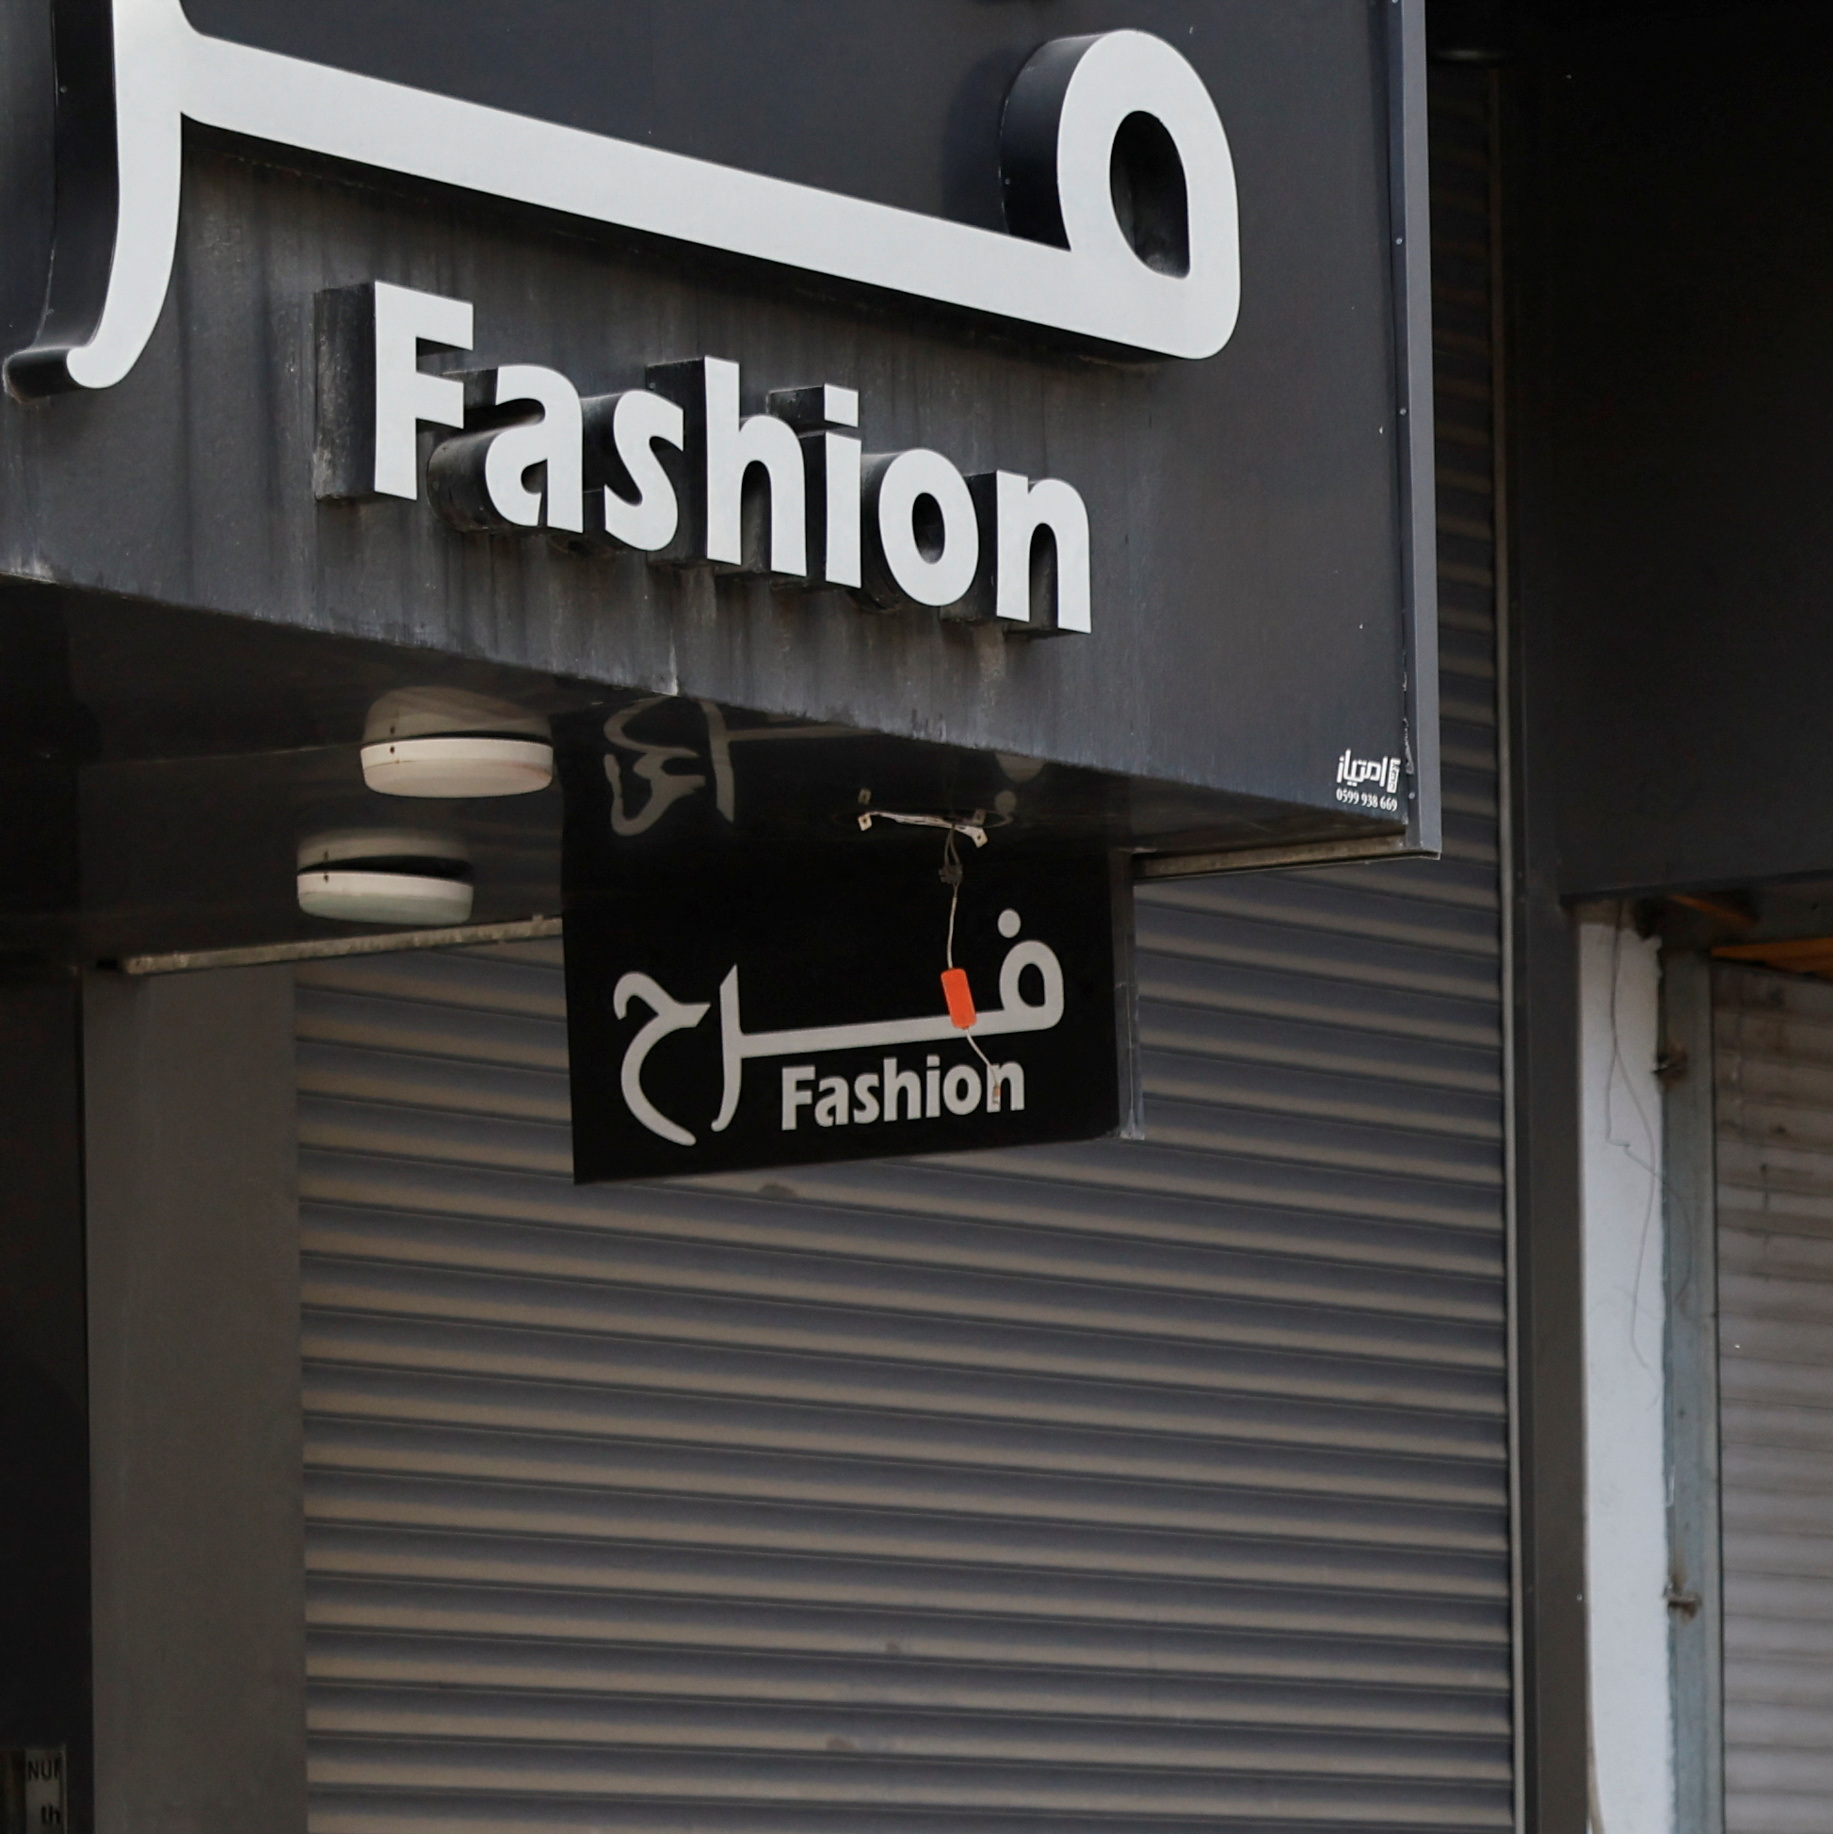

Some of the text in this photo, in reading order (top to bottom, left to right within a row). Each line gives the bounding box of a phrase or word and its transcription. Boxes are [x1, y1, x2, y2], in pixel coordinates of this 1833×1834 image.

[373, 281, 1092, 634] Fashion
[1336, 747, 1389, 788] امتياز
[1336, 787, 1399, 812] 0599 938 669
[613, 908, 1065, 1147] فرح
[780, 1053, 1025, 1133] Fashion
